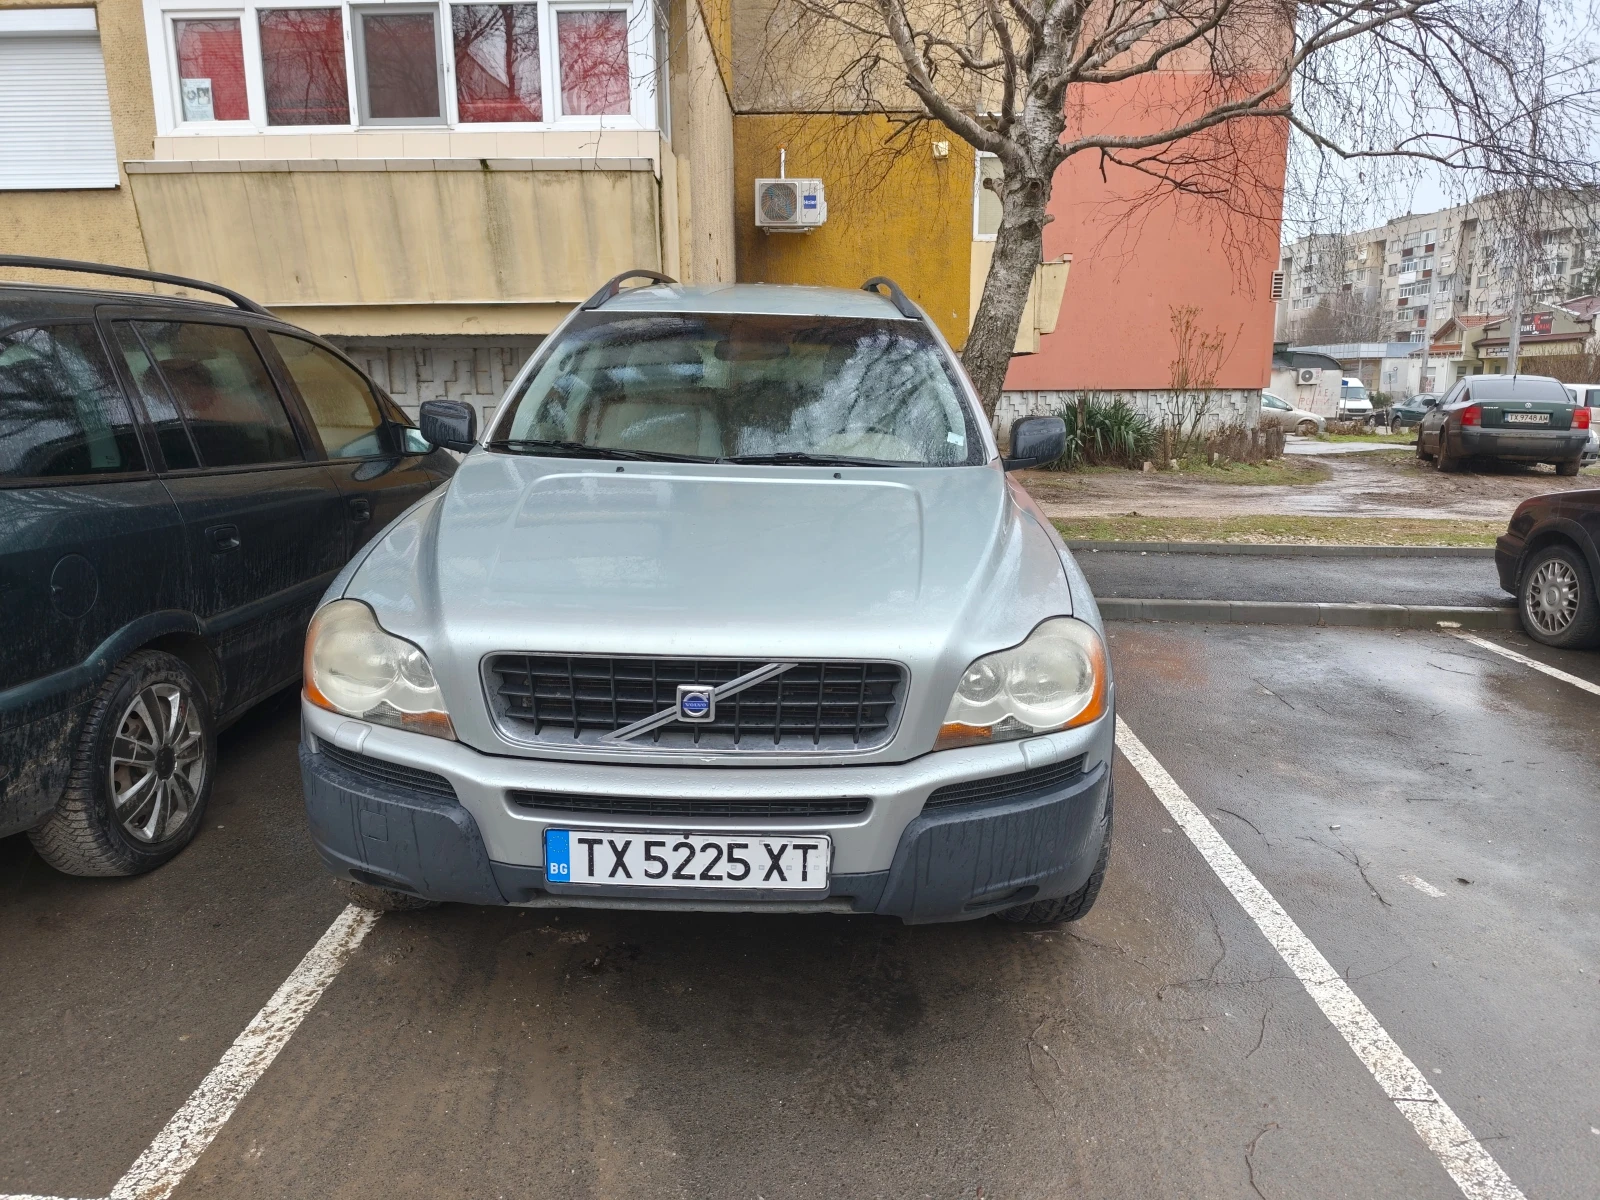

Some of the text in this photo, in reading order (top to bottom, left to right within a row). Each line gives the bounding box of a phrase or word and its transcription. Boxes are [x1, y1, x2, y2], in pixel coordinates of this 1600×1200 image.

[550, 862, 568, 875] BG
[577, 837, 819, 882] TX 5225 XT
